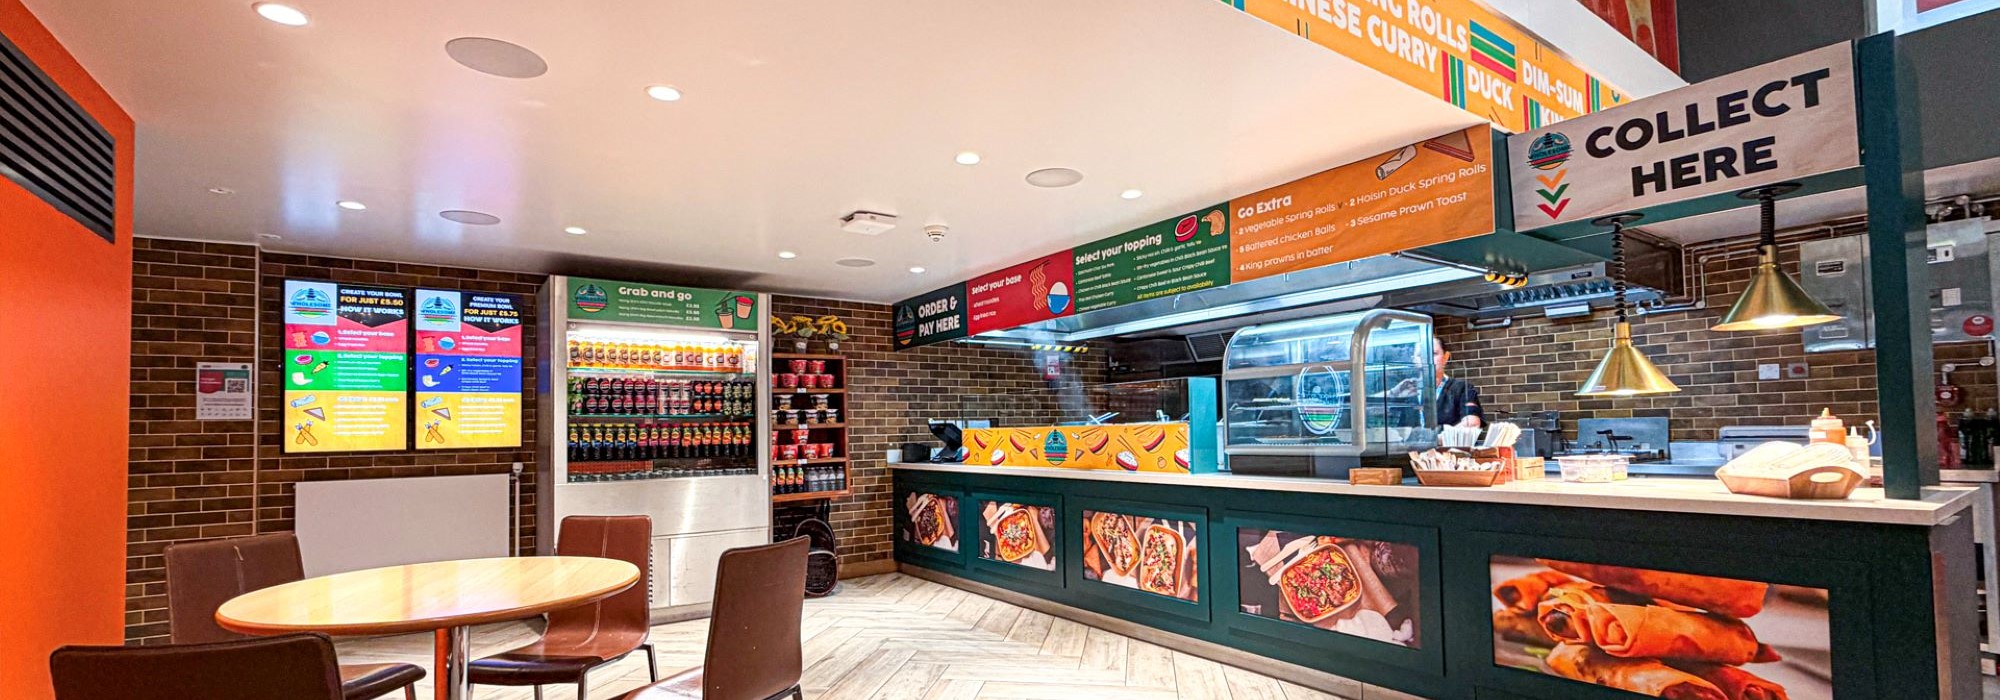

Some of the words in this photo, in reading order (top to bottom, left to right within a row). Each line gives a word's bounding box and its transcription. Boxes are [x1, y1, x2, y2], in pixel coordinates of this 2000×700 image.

[1407, 0, 1468, 53] ROLLS
[1366, 14, 1438, 73] CURRY
[1467, 65, 1514, 111] DUCK
[1522, 59, 1584, 114] DIM-SUM
[1585, 68, 1830, 159] COLLECT
[1631, 136, 1778, 197] HERE
[1349, 198, 1356, 207] 2
[1356, 190, 1387, 204] Hoisin
[1389, 183, 1417, 196] Duck
[1418, 172, 1456, 189] Spring
[1458, 163, 1487, 178] Rolls
[1237, 206, 1254, 219] Go
[1256, 195, 1292, 214] Extra
[1285, 209, 1314, 223] Spring
[1314, 203, 1336, 215] Rolls
[1349, 219, 1356, 227] 3
[1357, 209, 1398, 226] Sesame
[1400, 201, 1434, 216] Prawn
[1436, 192, 1468, 206] Toast
[1075, 253, 1101, 266] Select
[1101, 245, 1123, 261] your
[1124, 233, 1162, 253] topping
[1245, 238, 1279, 252] Battered
[1279, 230, 1313, 243] chicken
[1315, 223, 1336, 236] Balls
[1245, 260, 1263, 271] King
[1263, 254, 1295, 267] prawns
[1296, 250, 1304, 260] in
[1306, 245, 1334, 258] batter
[340, 288, 366, 296] CREATE
[618, 286, 649, 297] Grab
[650, 288, 675, 299] and
[676, 292, 692, 301] go
[971, 282, 989, 295] Select
[989, 279, 1005, 291] your
[1005, 274, 1022, 286] base
[339, 296, 358, 304] FOR
[358, 296, 379, 305] JUST
[372, 307, 404, 315] WORKS
[472, 295, 494, 303] CREATE
[918, 298, 949, 319] ORDER
[949, 295, 958, 310] &
[463, 315, 482, 323] HOW
[491, 317, 519, 325] WORKS
[919, 320, 935, 337] PAY
[935, 314, 960, 334] HERE
